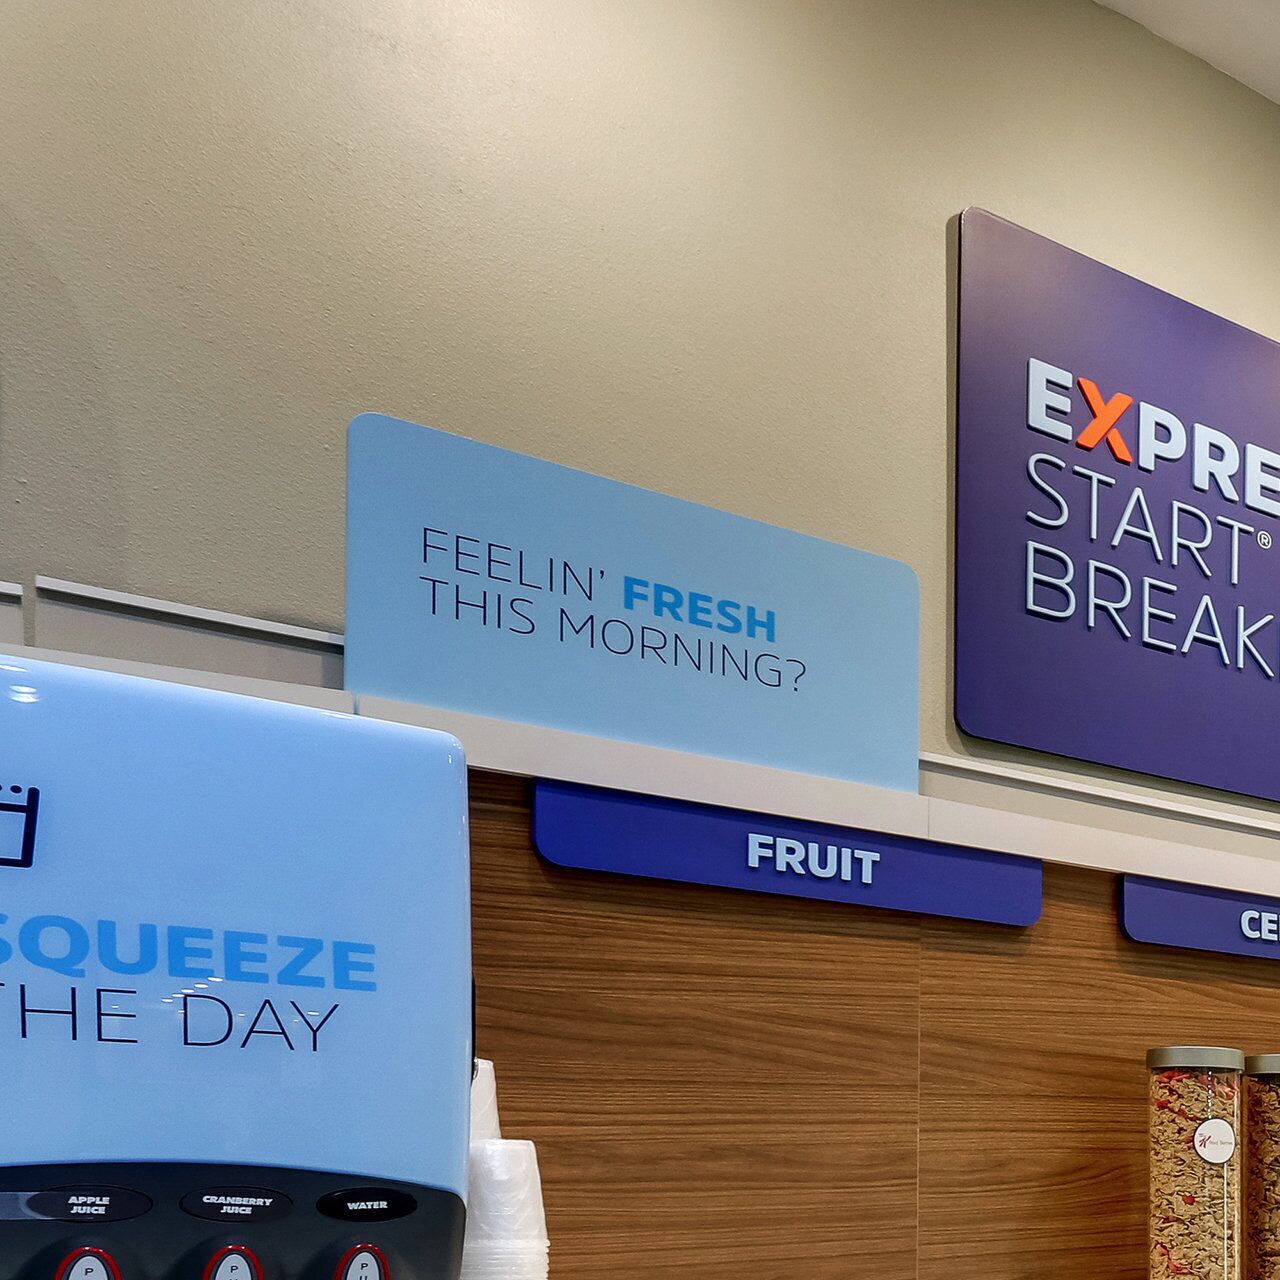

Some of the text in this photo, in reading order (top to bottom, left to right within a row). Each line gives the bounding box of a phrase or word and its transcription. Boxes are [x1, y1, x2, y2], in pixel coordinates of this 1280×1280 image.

[623, 575, 776, 643] FRESH
[418, 575, 807, 692] THIS MORNING?
[746, 832, 881, 885] FRUIT
[0, 913, 377, 993] QUEEZE
[0, 981, 340, 1053] HE DAY
[68, 1196, 110, 1205] APPLE
[70, 1205, 106, 1215] JUICE
[202, 1195, 273, 1206] CRANBERRY
[220, 1205, 252, 1215] JUICE
[347, 1200, 389, 1211] WATER
